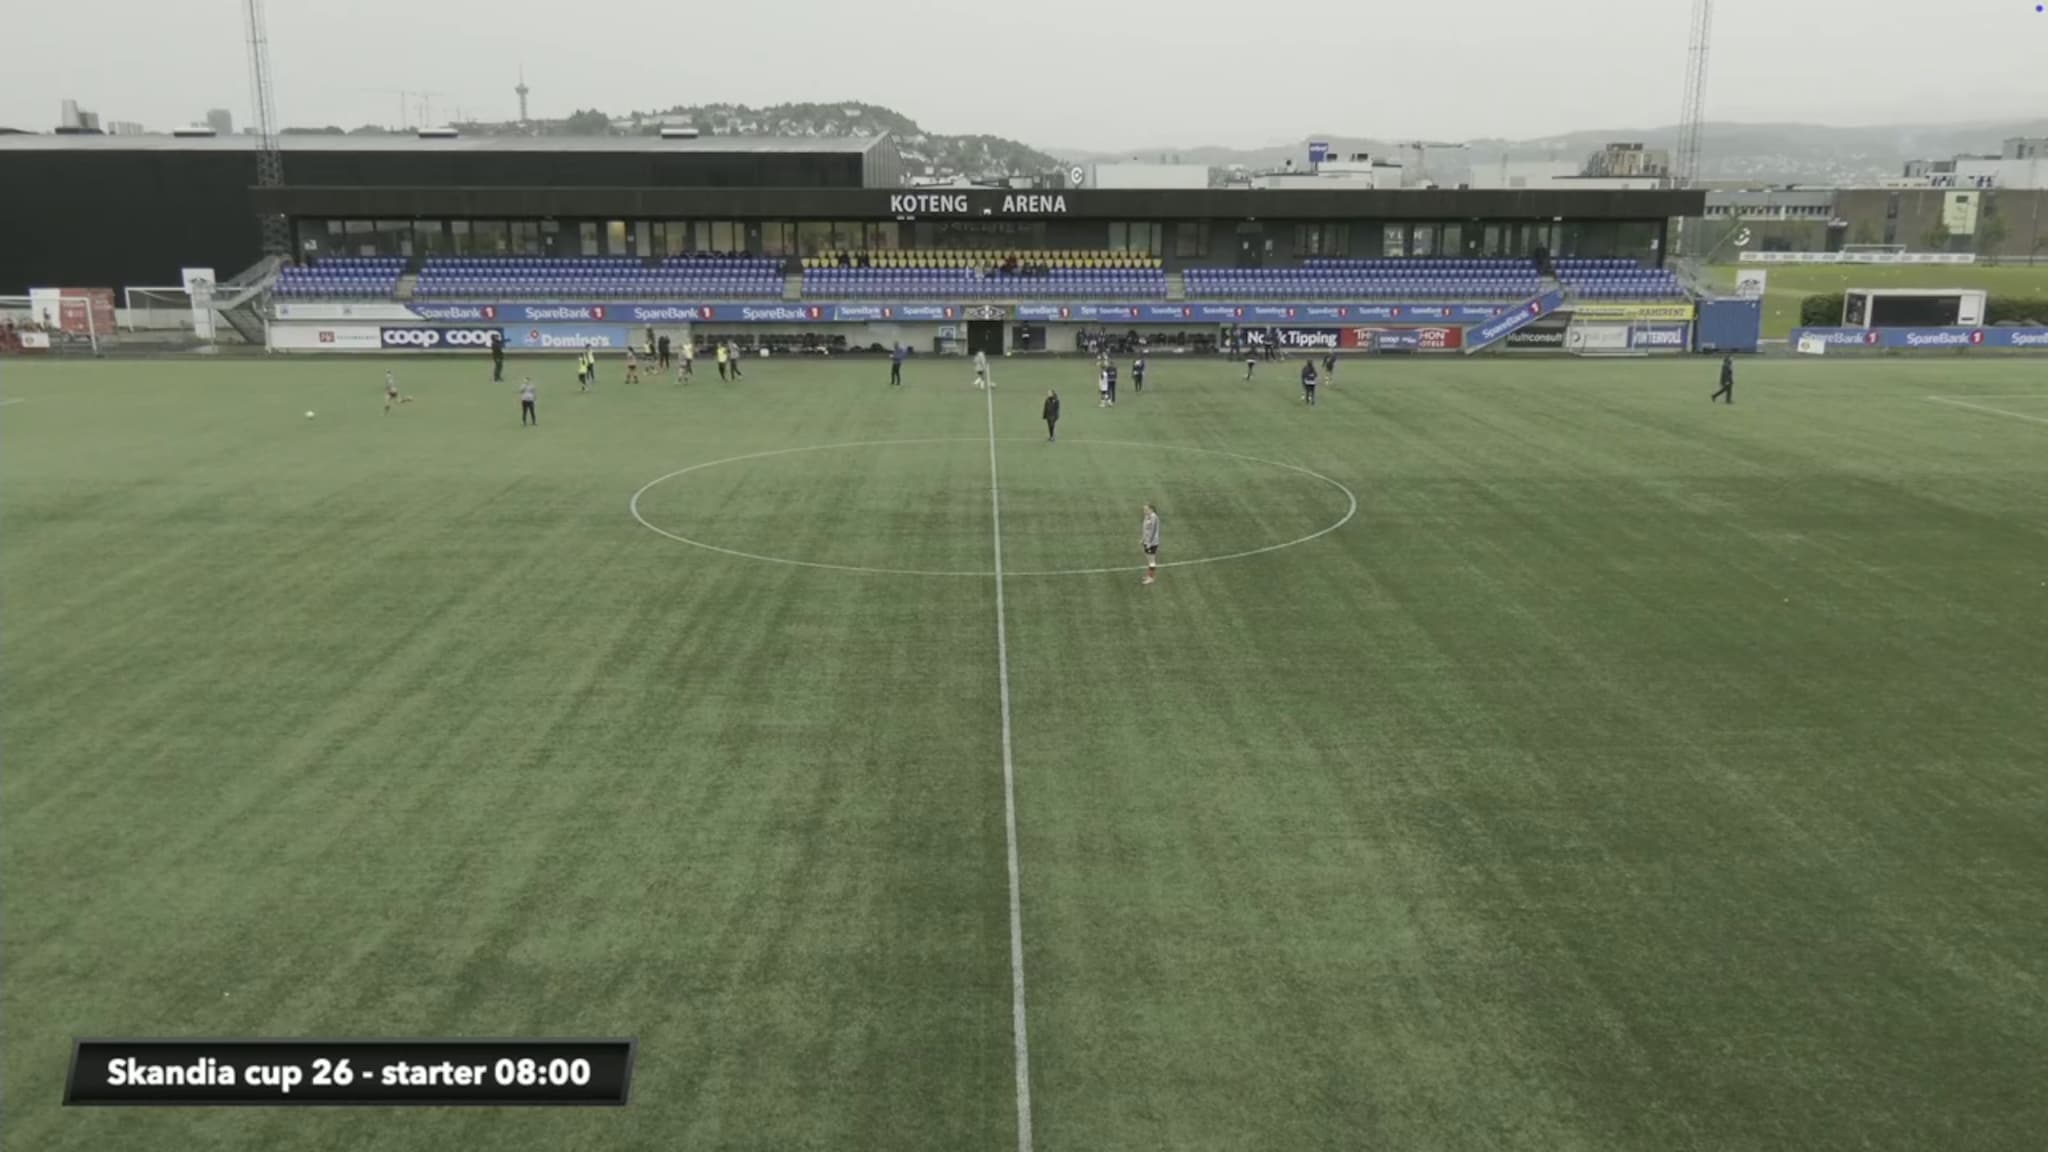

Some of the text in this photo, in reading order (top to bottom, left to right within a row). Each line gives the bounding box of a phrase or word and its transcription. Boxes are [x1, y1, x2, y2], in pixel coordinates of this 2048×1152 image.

[890, 195, 1067, 213] KOTENG ARENA
[525, 307, 590, 321] SpareBank
[634, 307, 699, 320] SpareBank
[742, 307, 806, 320] SpareBank
[383, 329, 502, 347] coop coop
[541, 334, 610, 347] Domino's
[1288, 330, 1338, 347] Tipping
[1906, 332, 1969, 345] SpareBank
